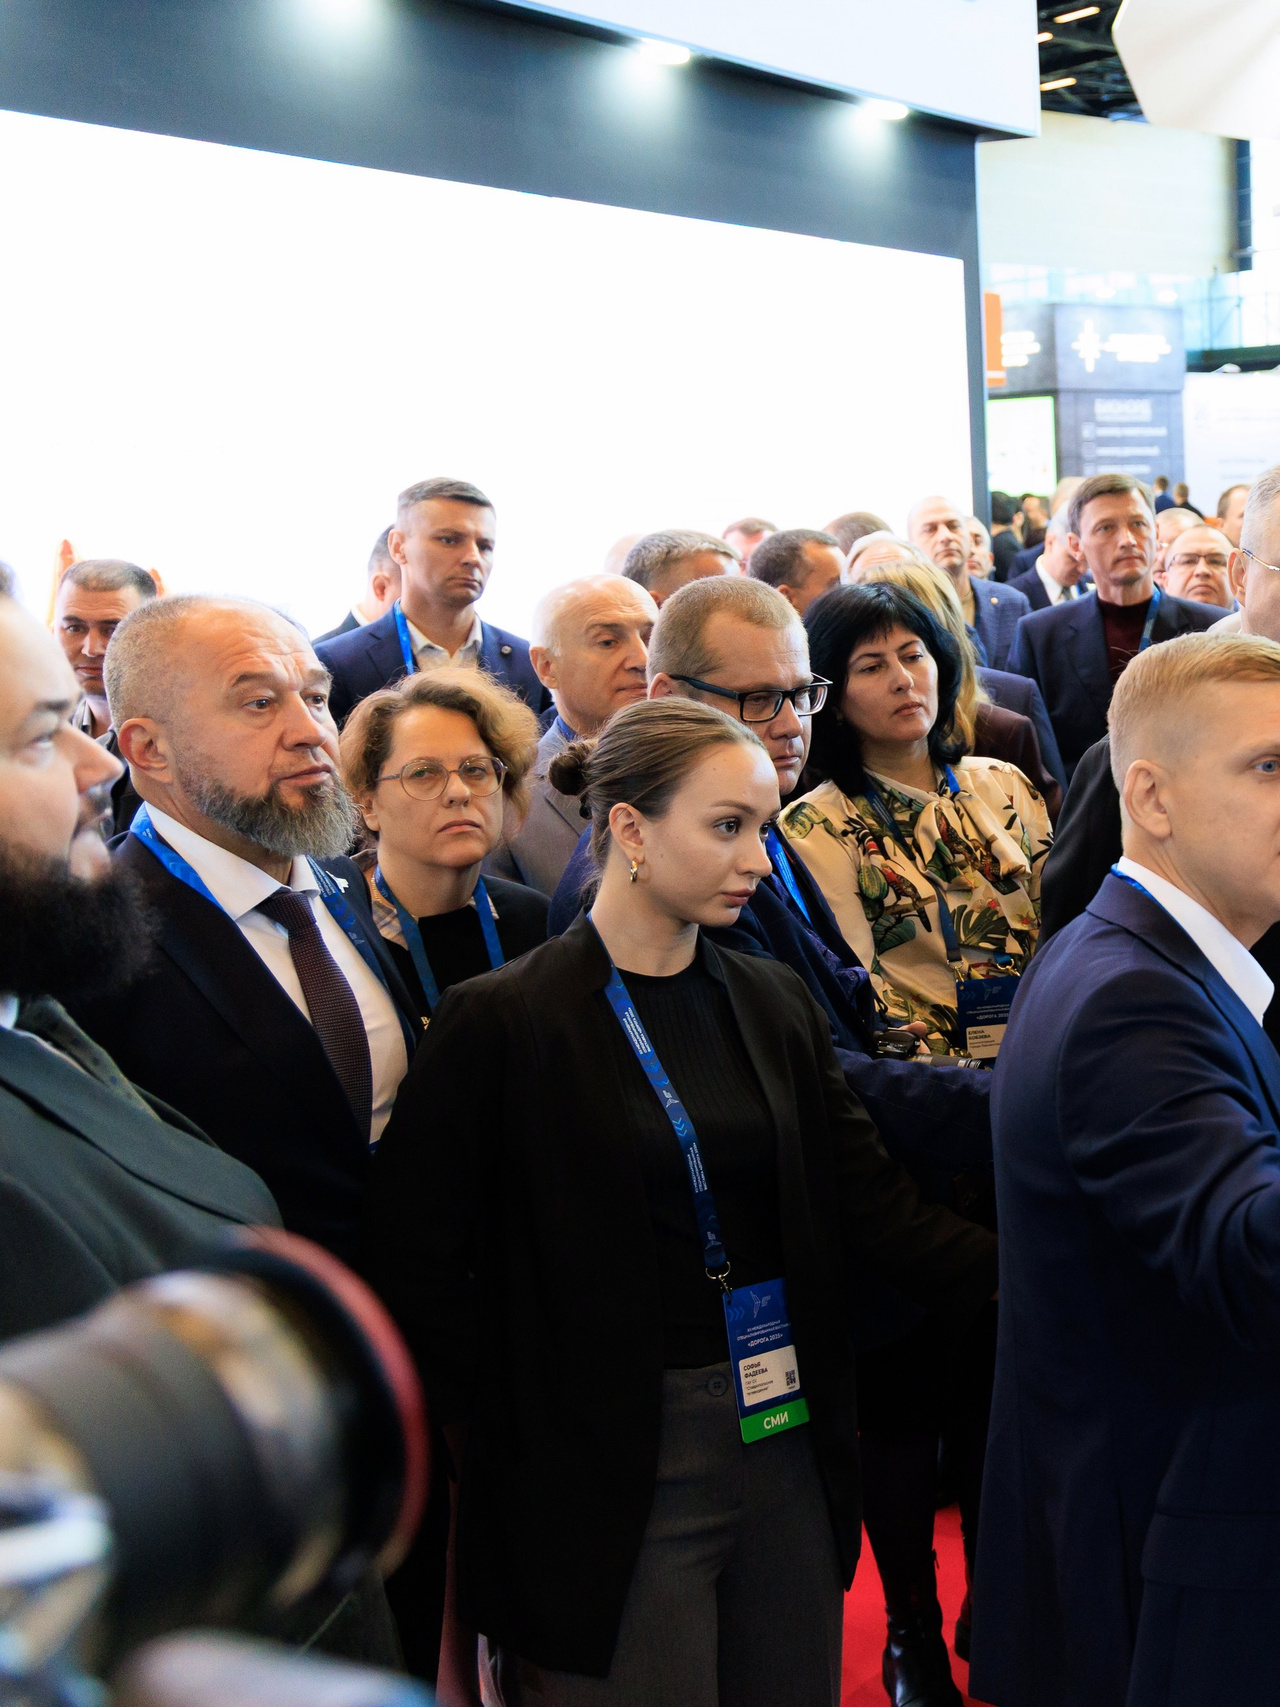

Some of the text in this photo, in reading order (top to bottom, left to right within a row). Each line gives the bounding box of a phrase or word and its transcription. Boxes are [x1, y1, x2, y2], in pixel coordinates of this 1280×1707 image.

[743, 1361, 761, 1372] СОФЬЯ
[744, 1367, 769, 1379] ФАДЕЕВА
[763, 1411, 789, 1430] СМИ
